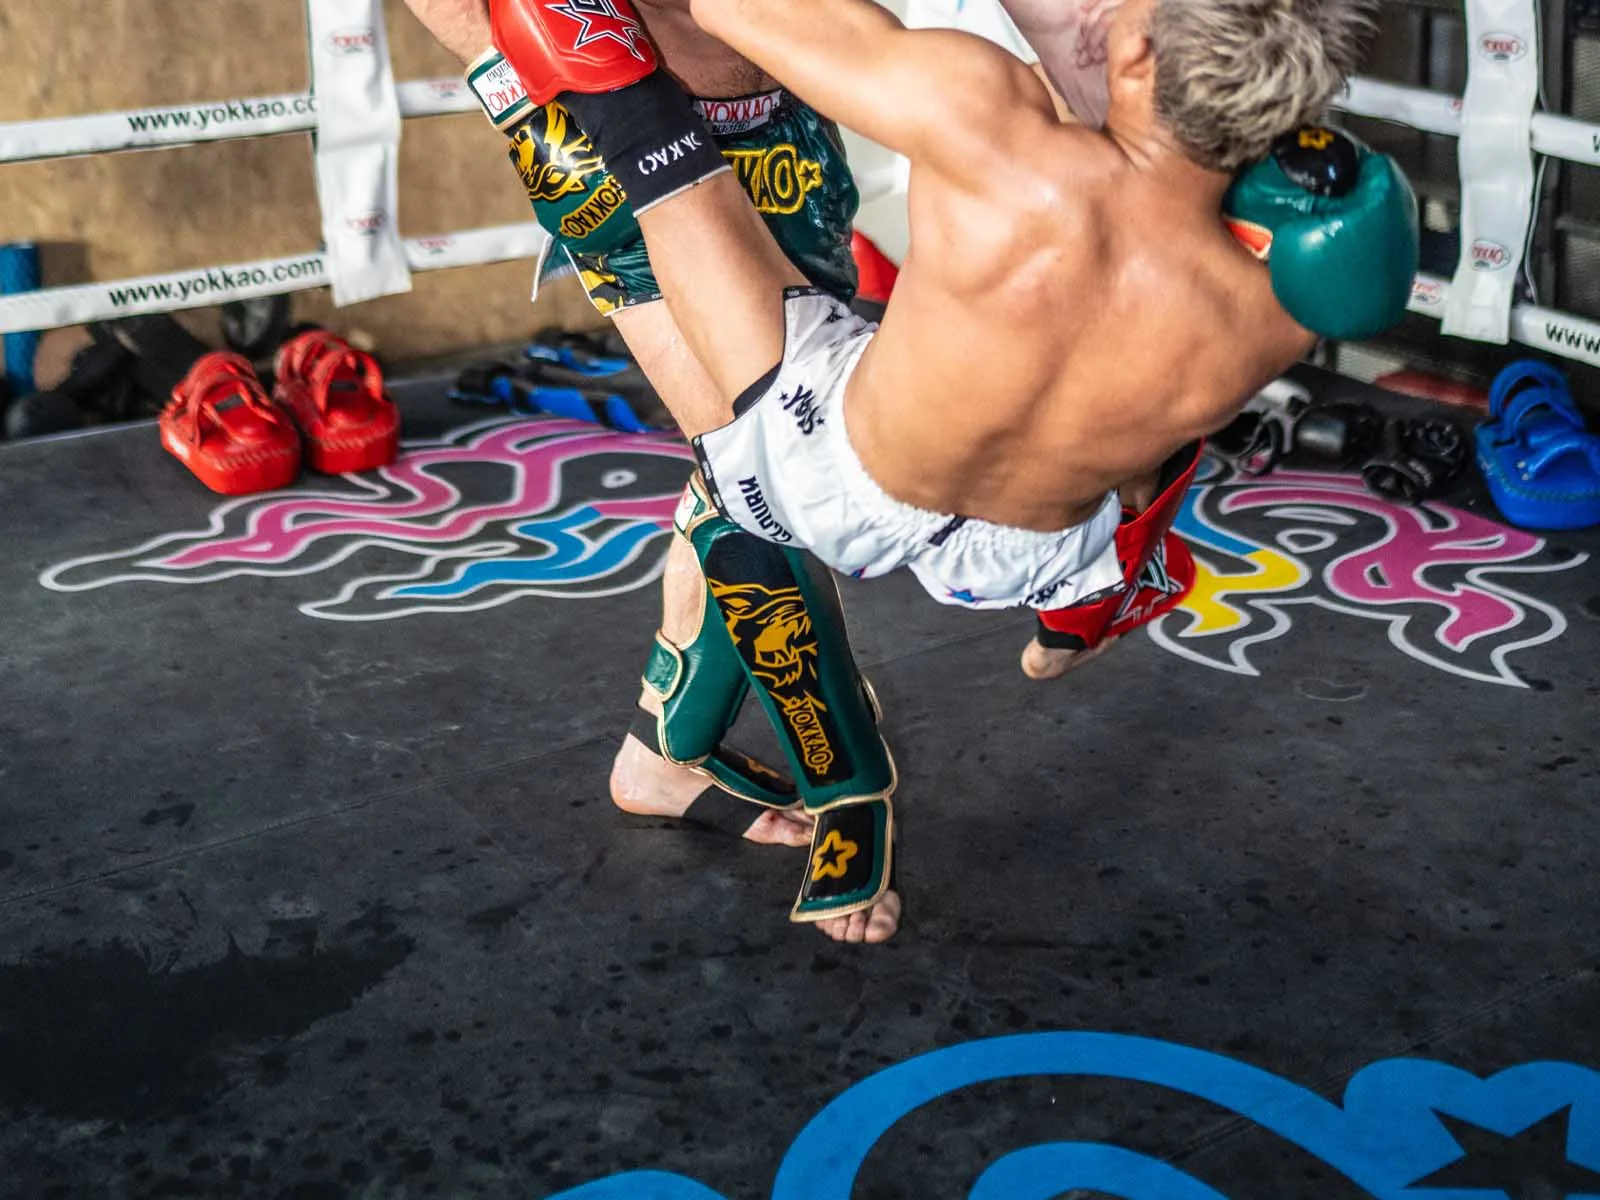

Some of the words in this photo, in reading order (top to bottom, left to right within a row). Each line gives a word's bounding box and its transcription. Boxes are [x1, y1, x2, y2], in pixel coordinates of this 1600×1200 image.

[703, 95, 773, 122] YOKKAO
[109, 257, 323, 307] www.yokkao.com
[784, 695, 834, 768] YOKKAO
